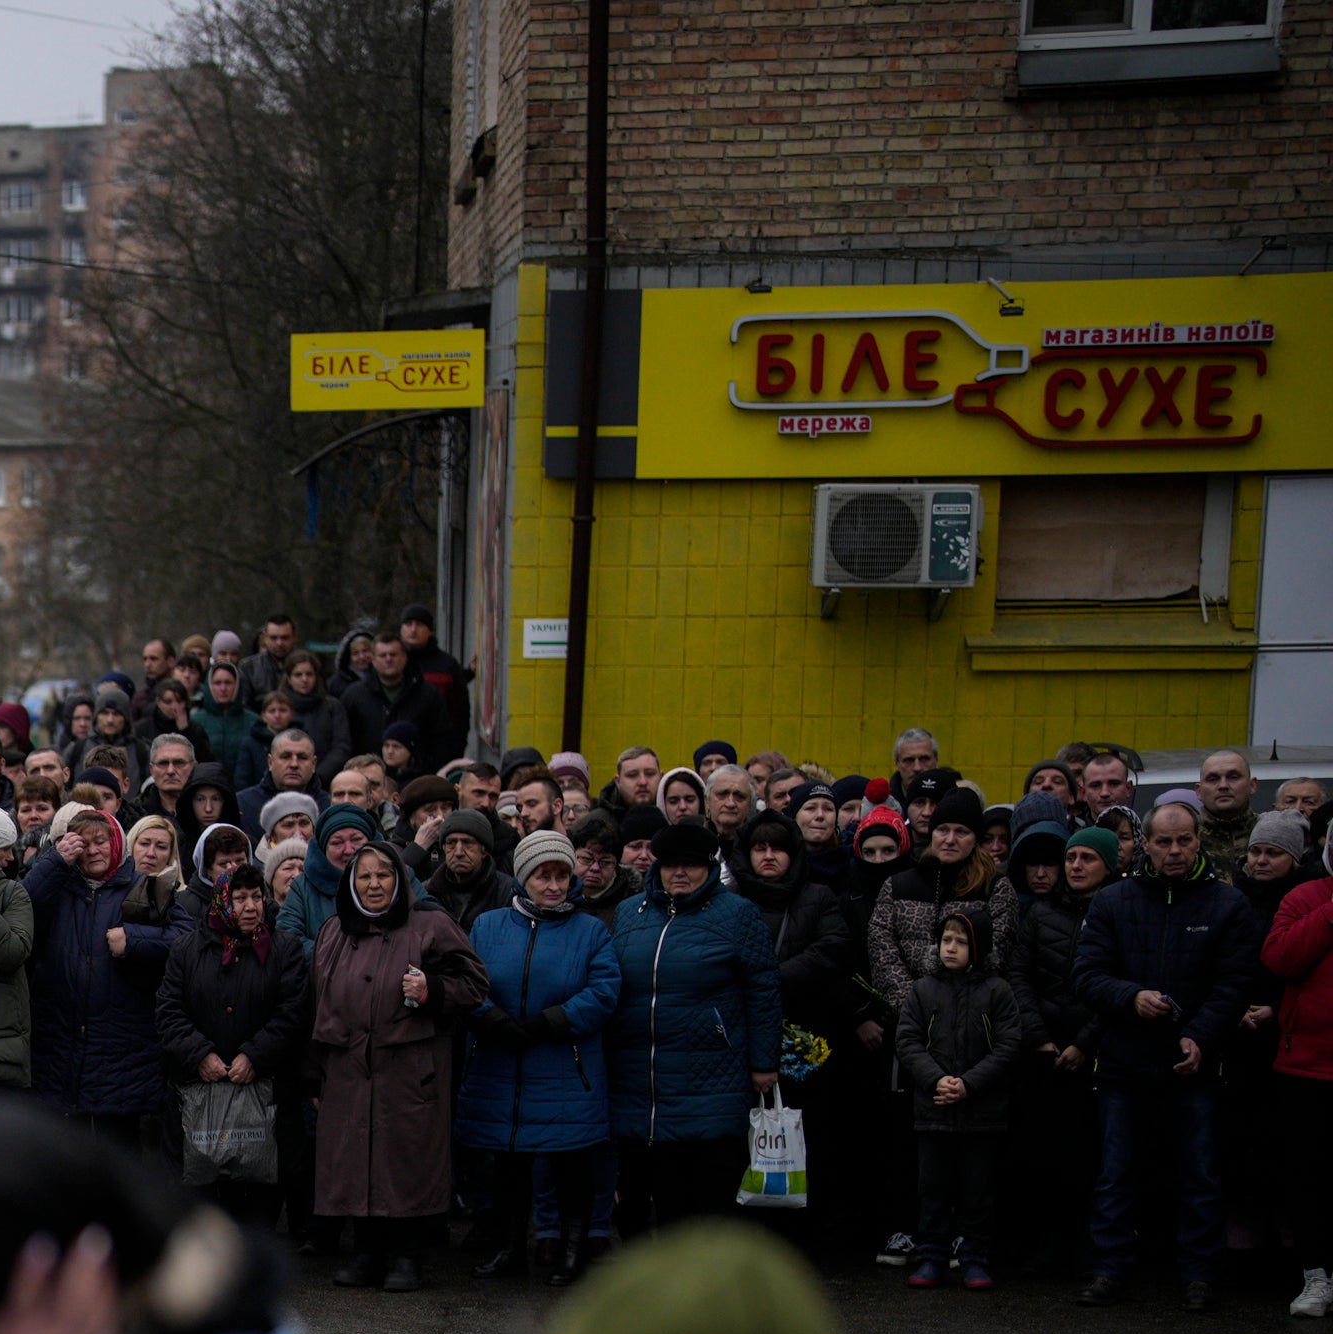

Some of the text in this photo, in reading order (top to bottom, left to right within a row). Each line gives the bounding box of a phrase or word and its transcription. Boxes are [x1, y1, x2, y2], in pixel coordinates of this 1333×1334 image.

[1044, 319, 1275, 345] магазинів напоїв
[312, 355, 370, 376] БІЛЕ
[756, 330, 942, 396] БІЛЕ
[402, 365, 461, 385] СУХЕ
[1043, 364, 1237, 429] СУХЕ
[779, 416, 871, 436] мережа
[193, 1130, 265, 1142] GRAND IMPERIAL
